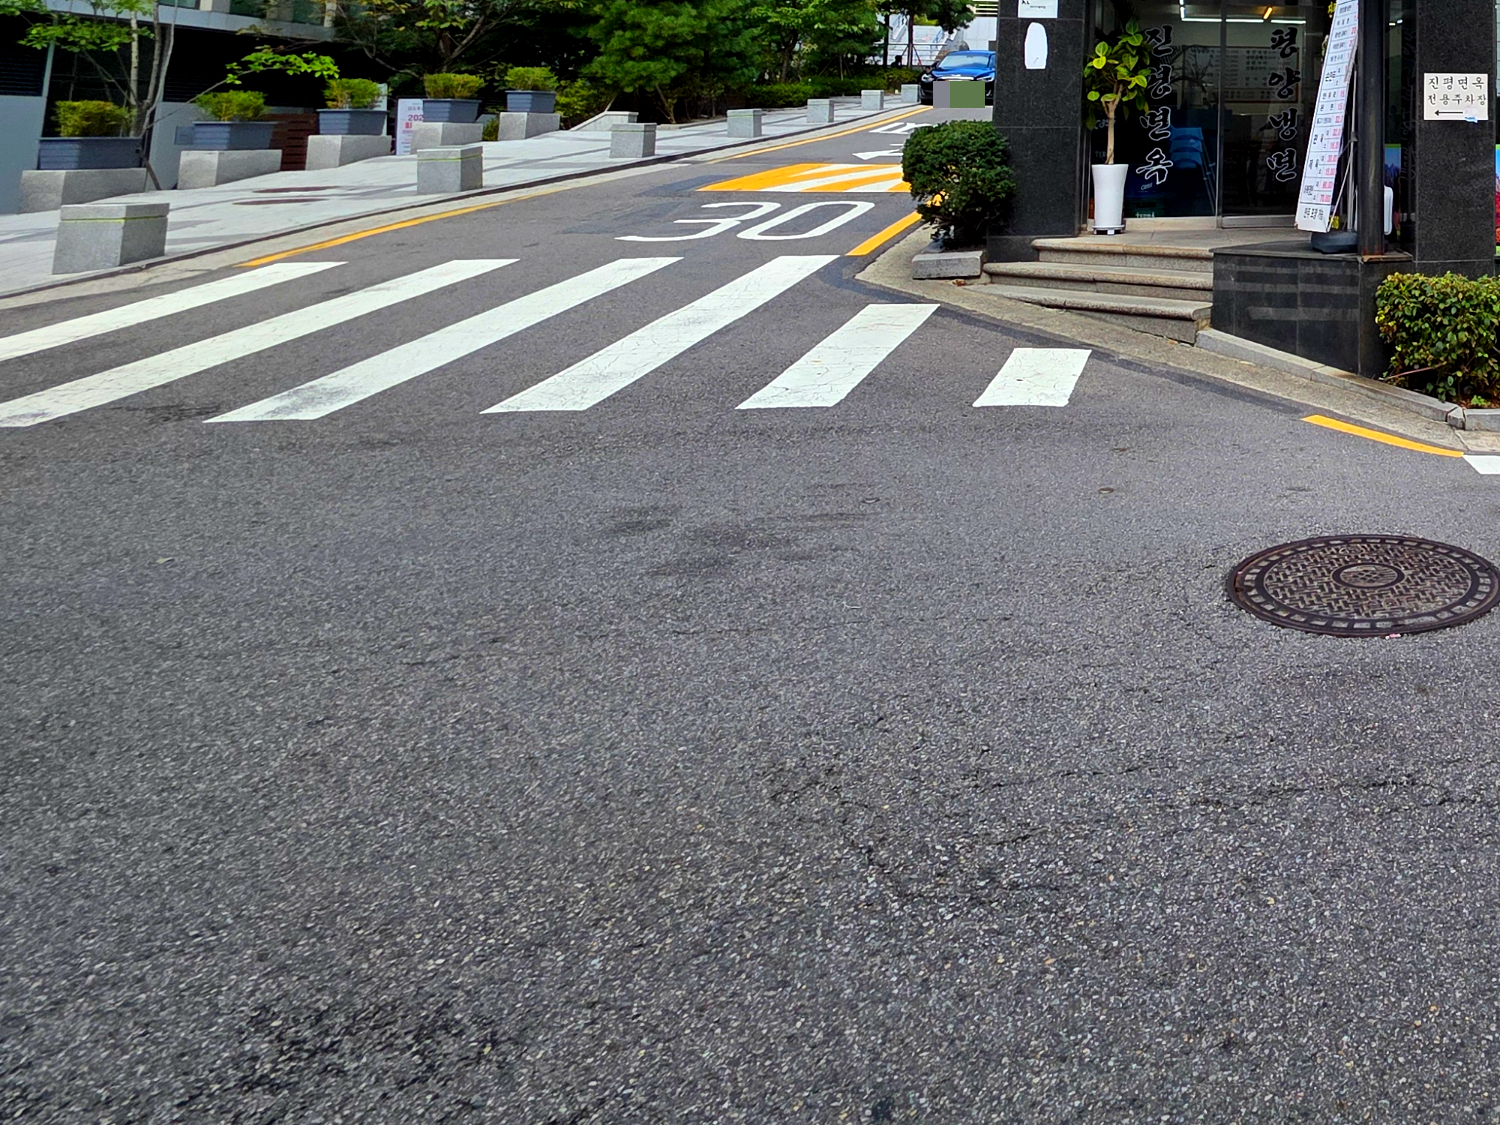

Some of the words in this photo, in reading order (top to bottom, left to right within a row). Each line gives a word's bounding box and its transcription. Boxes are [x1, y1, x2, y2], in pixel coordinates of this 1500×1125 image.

[1428, 75, 1485, 90] 진평면옥
[1266, 26, 1301, 183] 평양냉면
[1427, 93, 1487, 106] 전용주차장
[613, 200, 876, 242] 30
